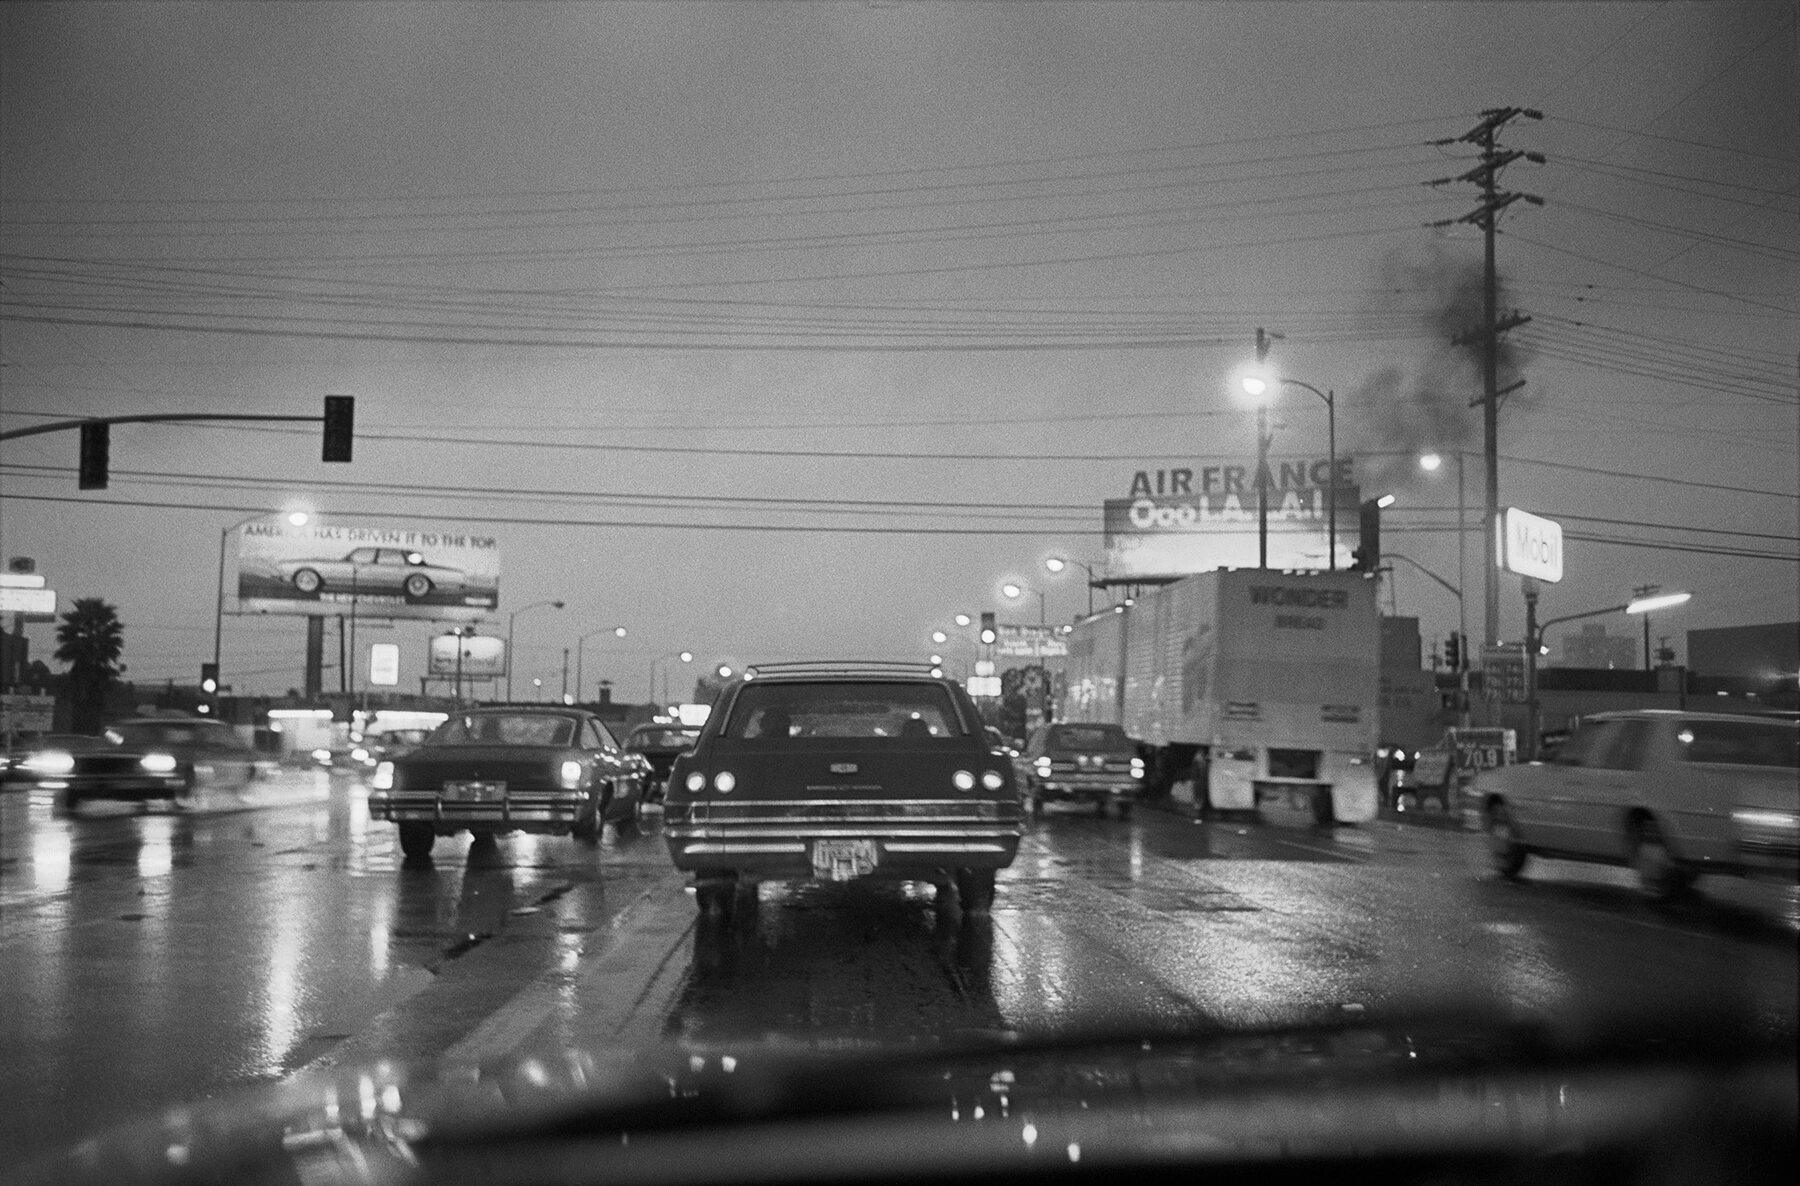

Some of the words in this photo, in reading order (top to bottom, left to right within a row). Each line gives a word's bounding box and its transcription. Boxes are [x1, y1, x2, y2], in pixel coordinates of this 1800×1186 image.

[1130, 468, 1194, 496] AIR
[1203, 457, 1354, 496] FRANCE
[245, 524, 308, 539] AMERA
[314, 529, 341, 540] HAS
[348, 528, 401, 543] DRIVEN
[405, 532, 416, 544] IT
[420, 533, 438, 547] TO
[442, 534, 465, 548] THE
[1516, 523, 1558, 569] Mobil
[1248, 586, 1348, 609] WONDER
[1464, 748, 1497, 768] 70.9
